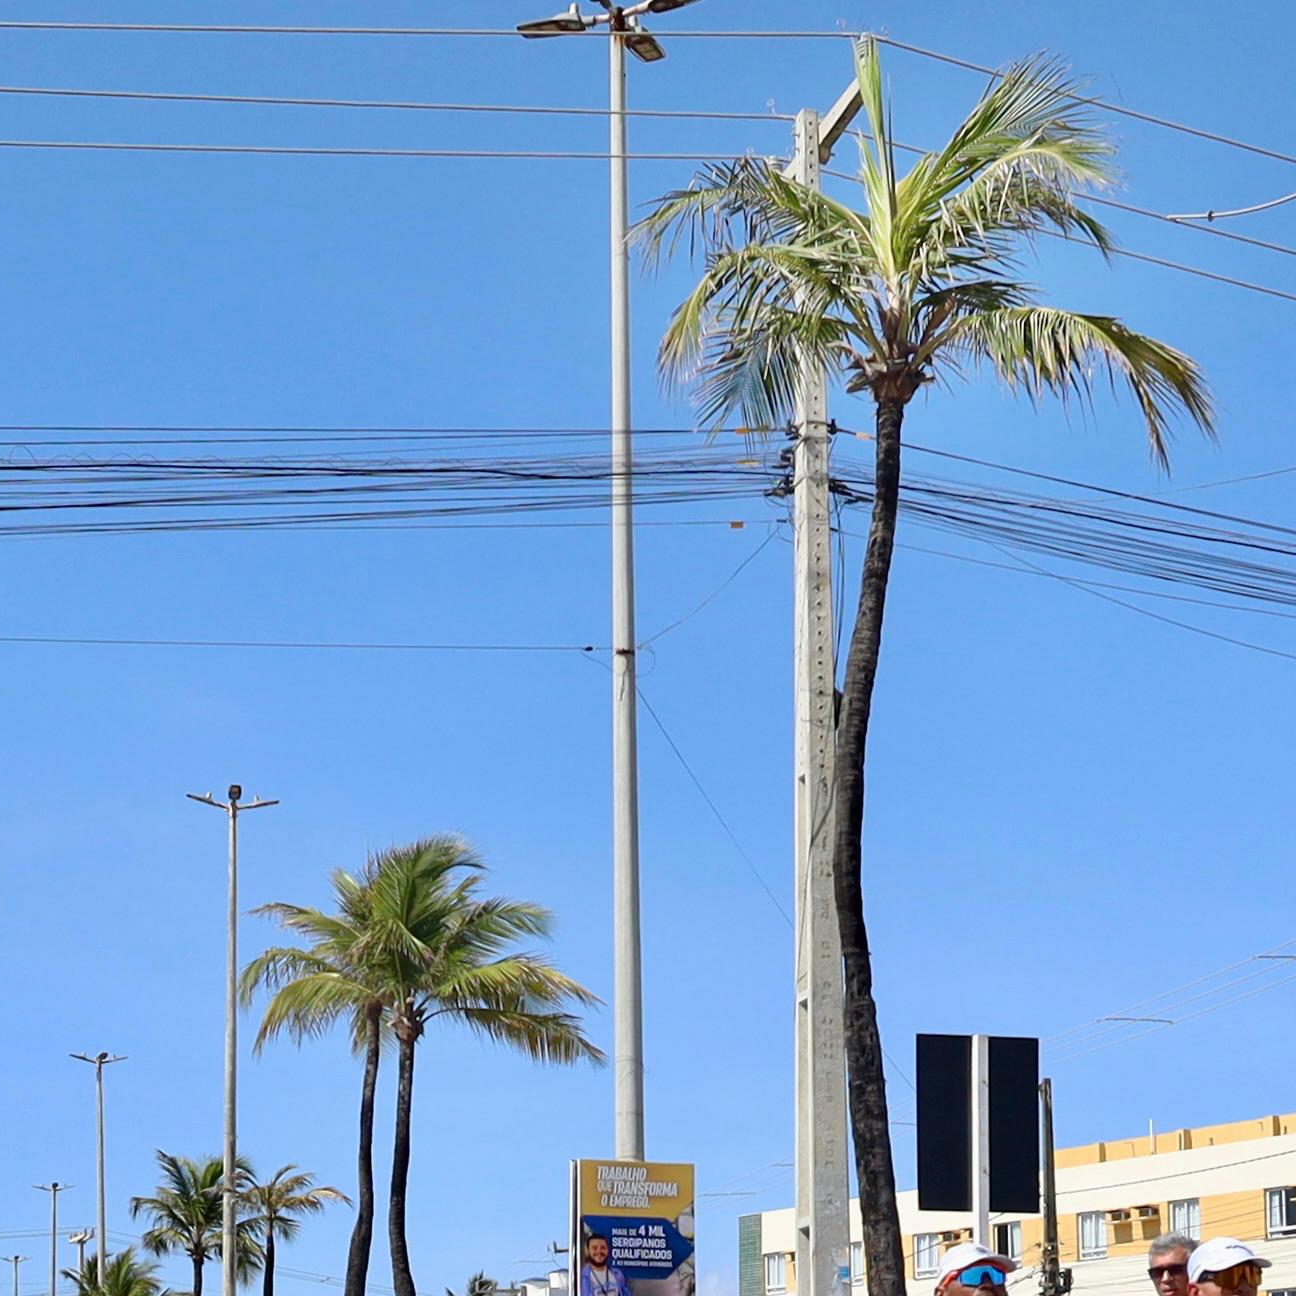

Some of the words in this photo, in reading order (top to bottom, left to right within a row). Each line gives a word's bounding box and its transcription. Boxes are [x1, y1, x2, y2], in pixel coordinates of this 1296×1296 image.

[597, 1166, 647, 1181] TRABALHO
[597, 1181, 613, 1193] QUE
[612, 1181, 678, 1197] TRANSFORMA
[601, 1194, 608, 1206] O
[638, 1224, 646, 1237] 4
[648, 1225, 666, 1238] MIL
[612, 1237, 666, 1249] SERGIPANOS
[612, 1249, 672, 1260] QUALIFICADOS
